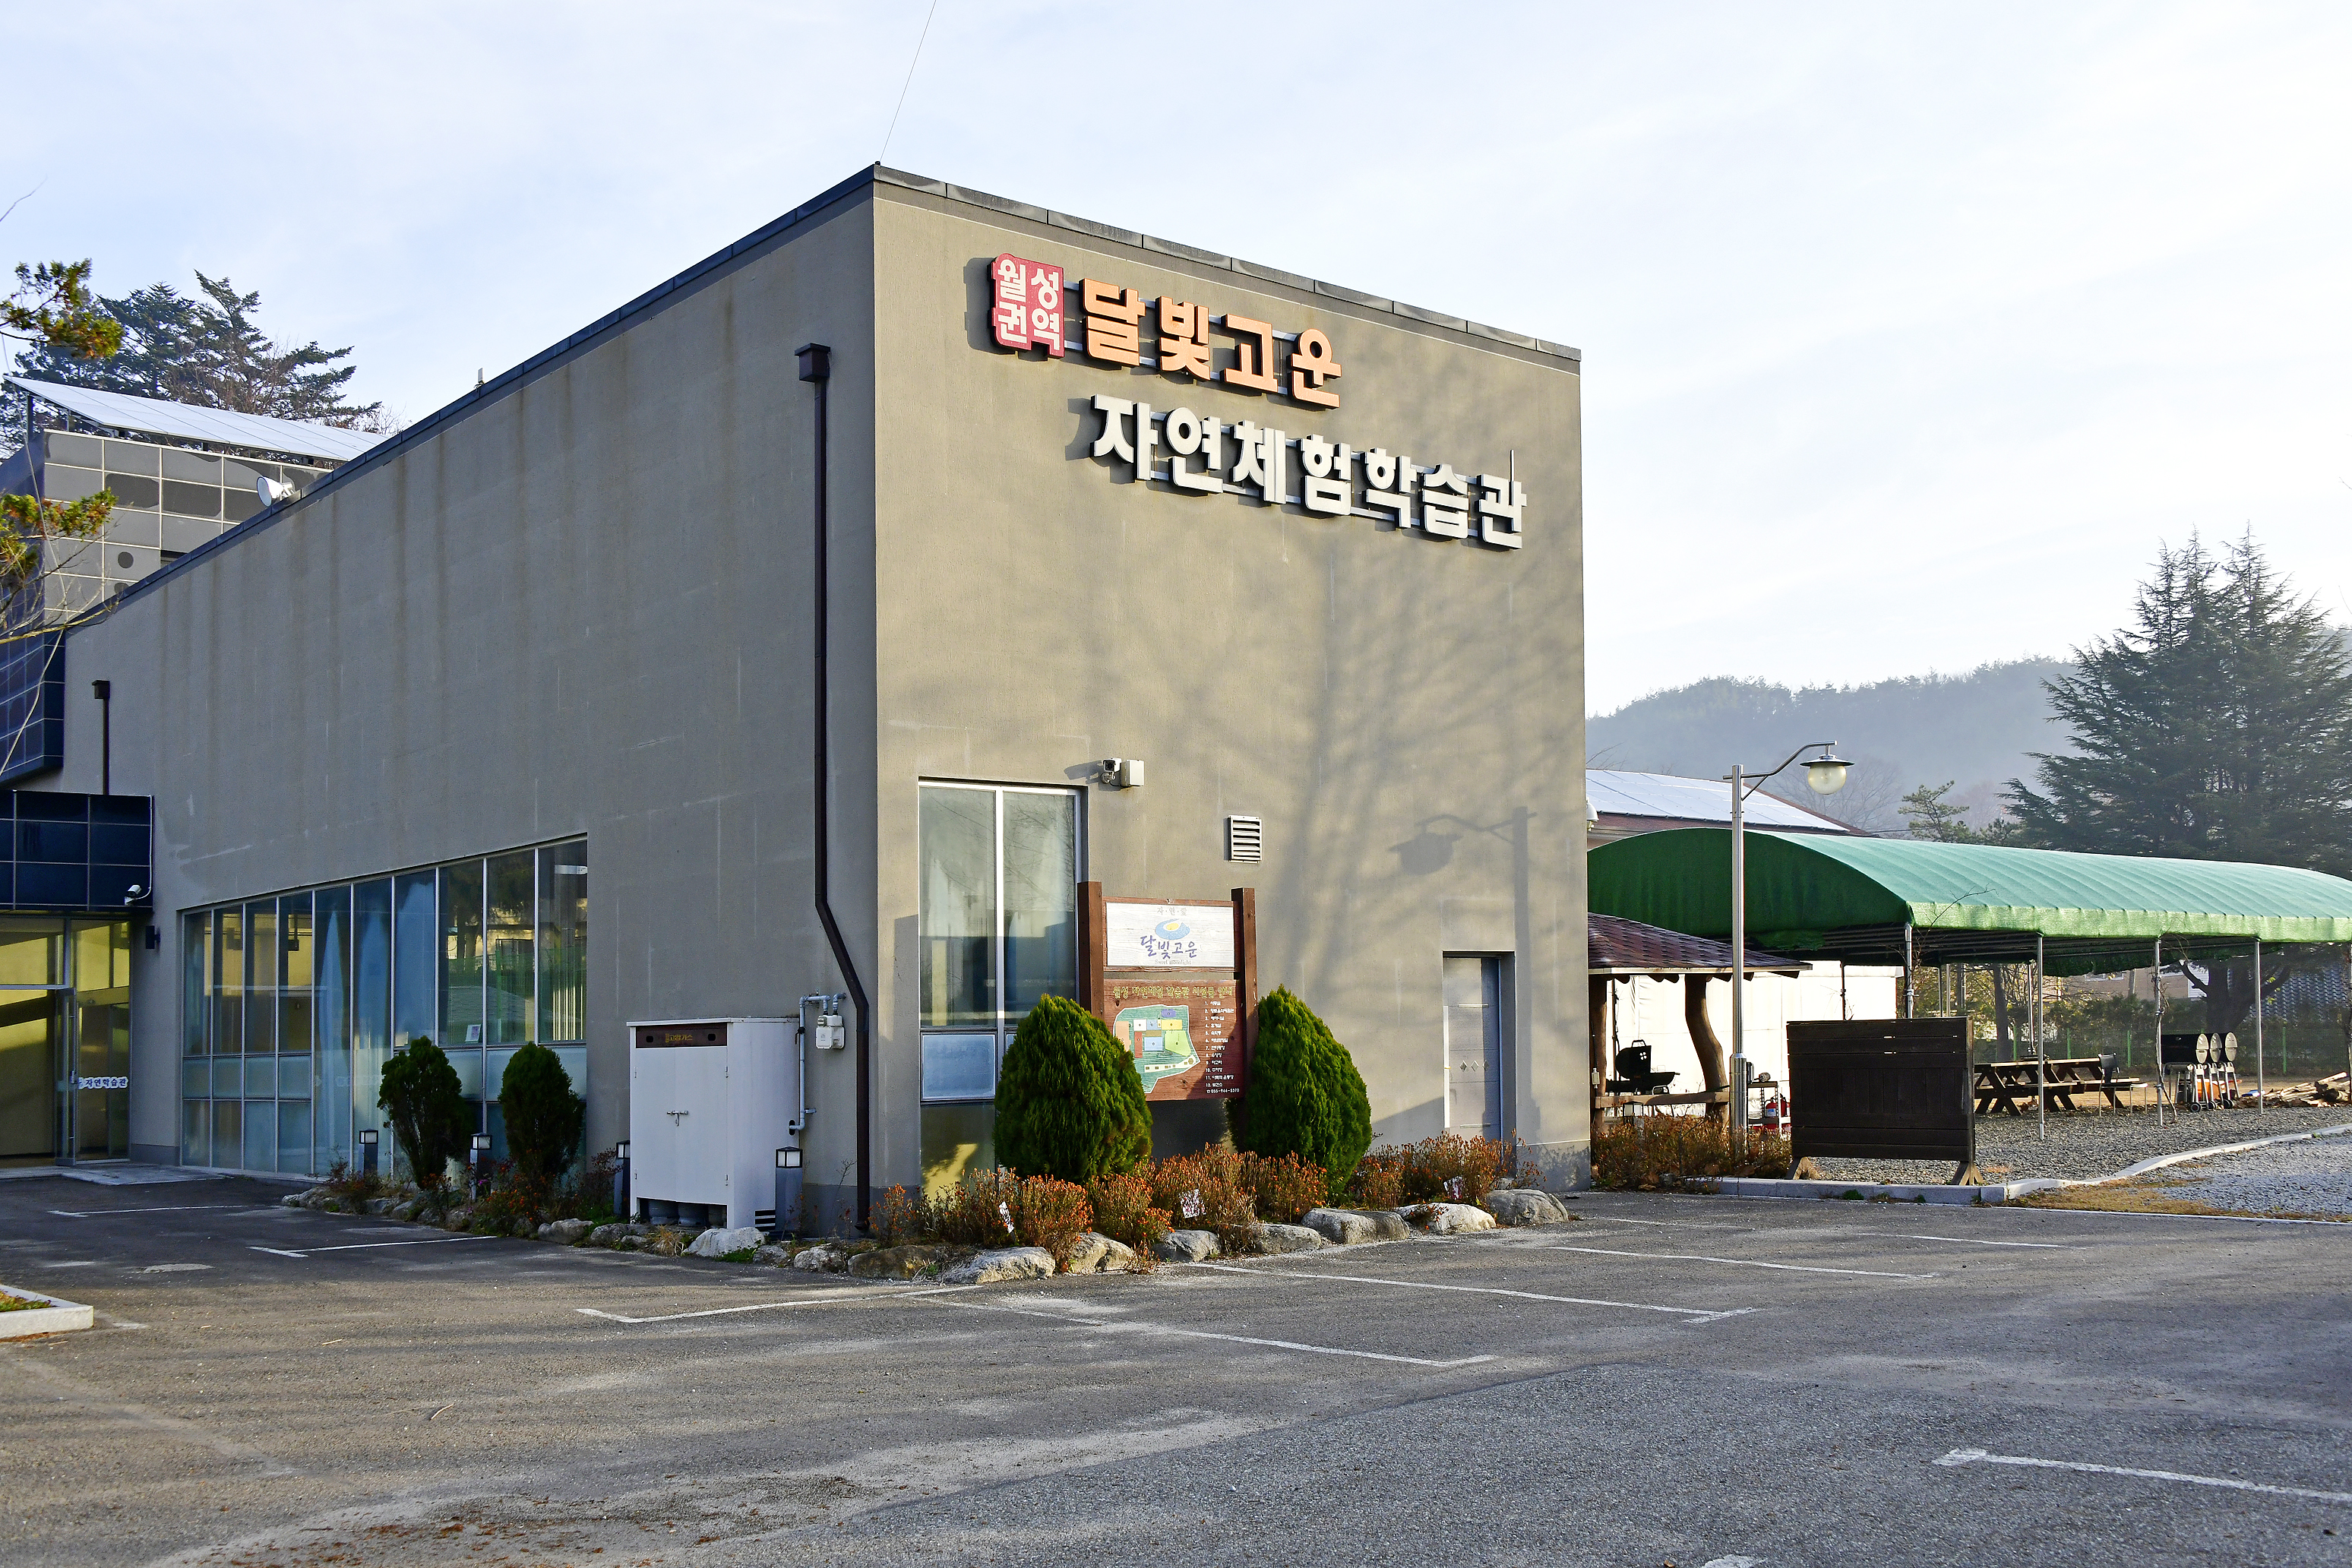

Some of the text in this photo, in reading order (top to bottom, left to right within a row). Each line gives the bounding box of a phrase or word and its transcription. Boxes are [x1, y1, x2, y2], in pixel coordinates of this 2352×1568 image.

[997, 259, 1059, 310] 월성
[997, 301, 1060, 350] 권역
[1090, 394, 1528, 549] 자연체험학습관
[1140, 935, 1197, 959] 달빛고운
[1112, 986, 1129, 999] 월성
[1132, 986, 1164, 999] 자연체험
[1166, 986, 1190, 999] 학습관
[1217, 986, 1233, 999] 안내
[85, 1078, 127, 1087] 자연학습관
